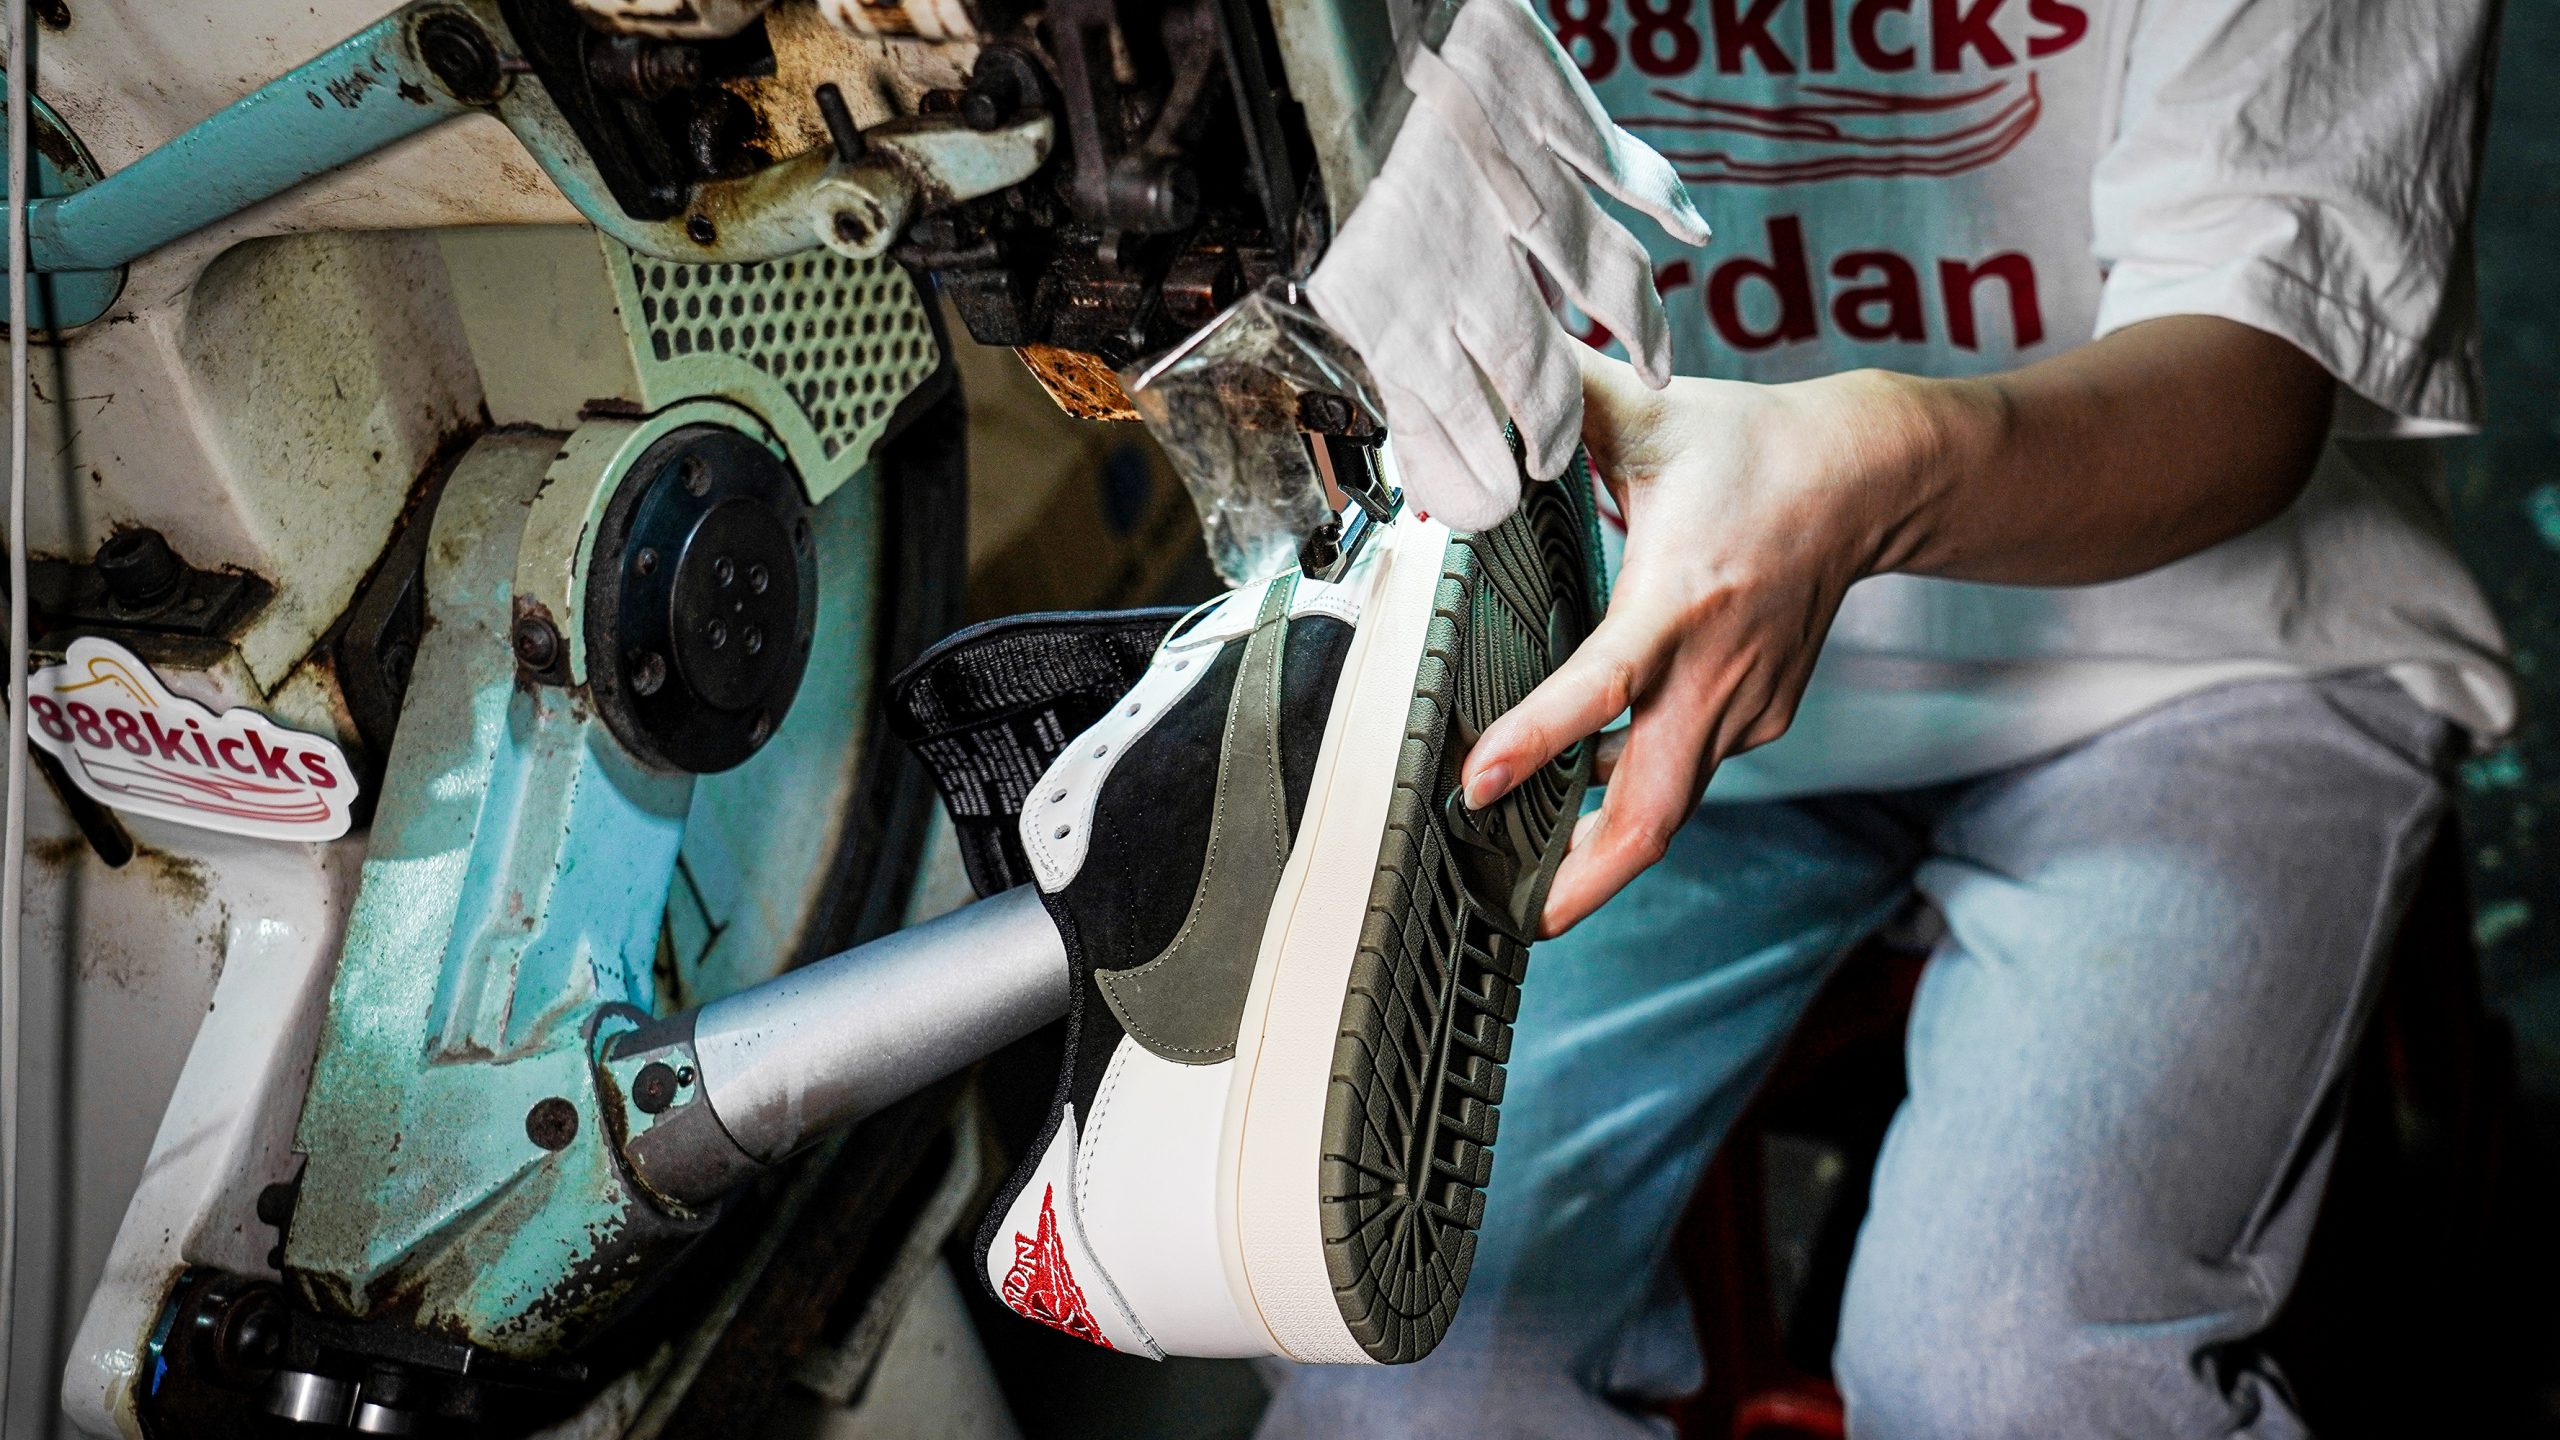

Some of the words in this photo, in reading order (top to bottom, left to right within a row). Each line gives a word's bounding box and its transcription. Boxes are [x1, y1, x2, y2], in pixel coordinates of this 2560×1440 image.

[1550, 0, 2087, 82] 88kicks
[28, 695, 338, 789] 888kicks
[1005, 1241, 1037, 1315] ORDAN
